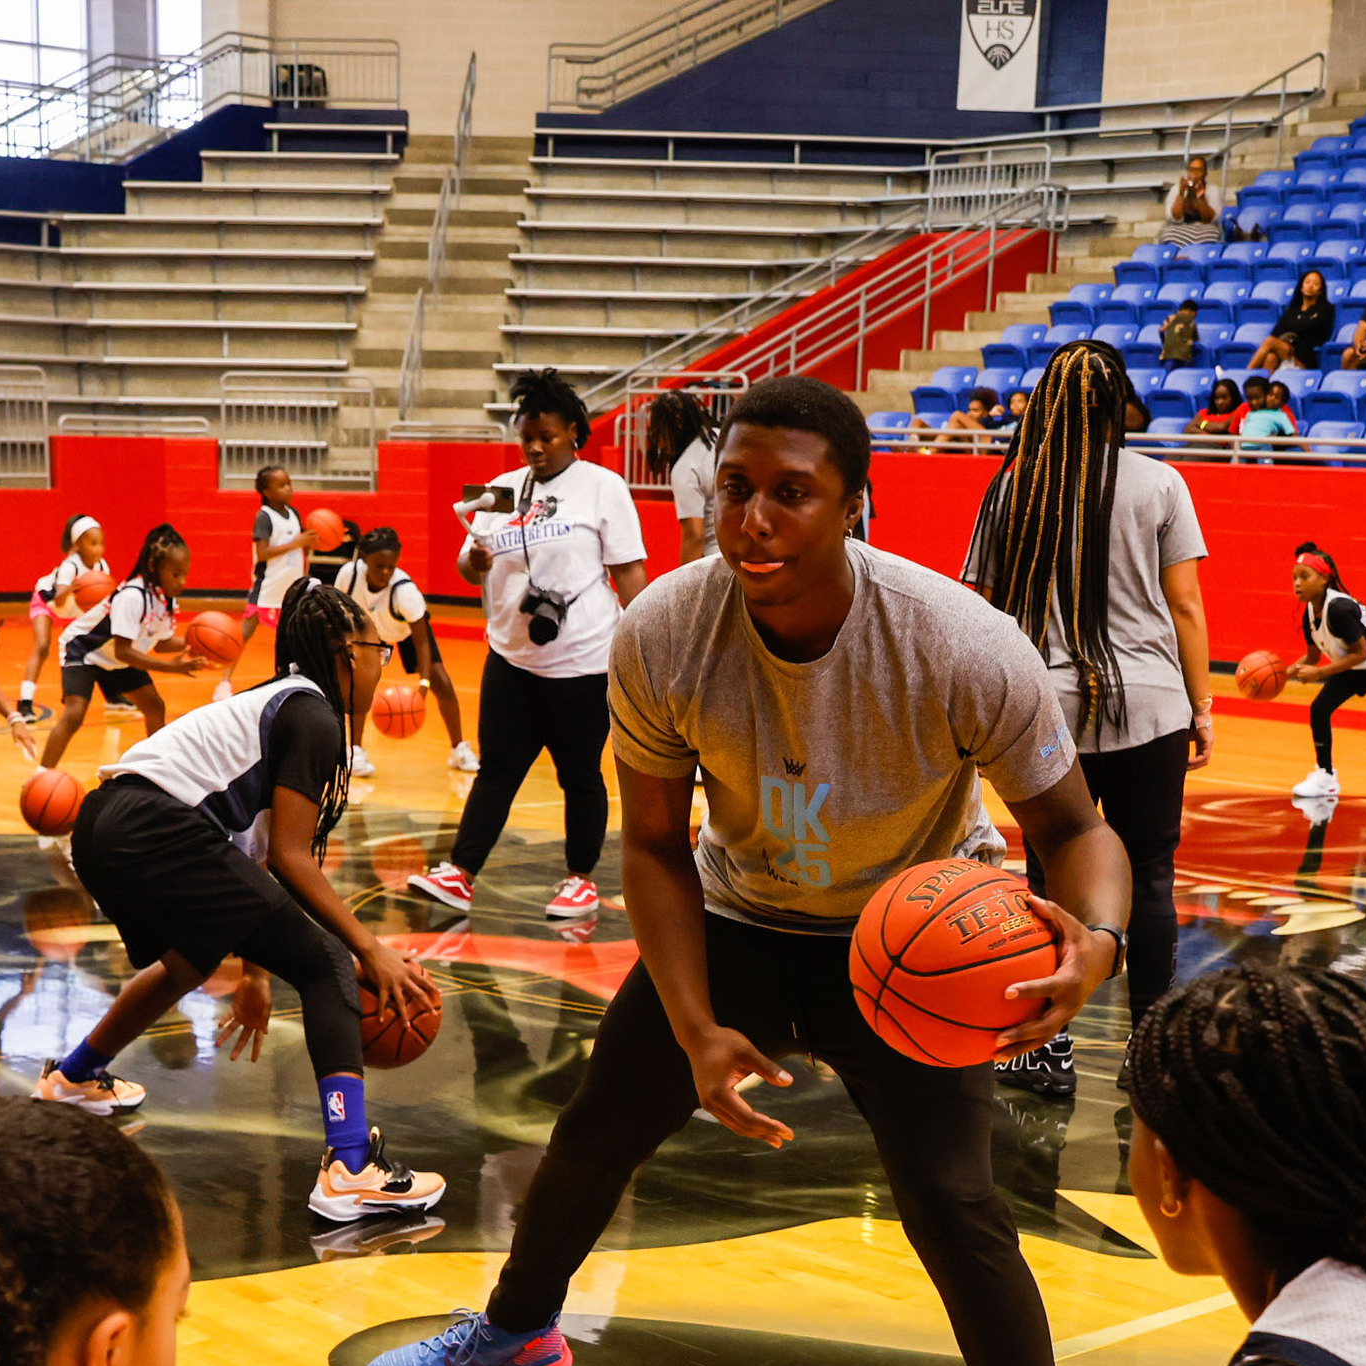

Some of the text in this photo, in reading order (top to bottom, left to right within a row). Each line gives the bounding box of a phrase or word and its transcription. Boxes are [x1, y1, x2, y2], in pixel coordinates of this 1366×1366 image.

[986, 20, 1015, 40] HS
[761, 775, 831, 842] DK
[775, 842, 832, 888] 25
